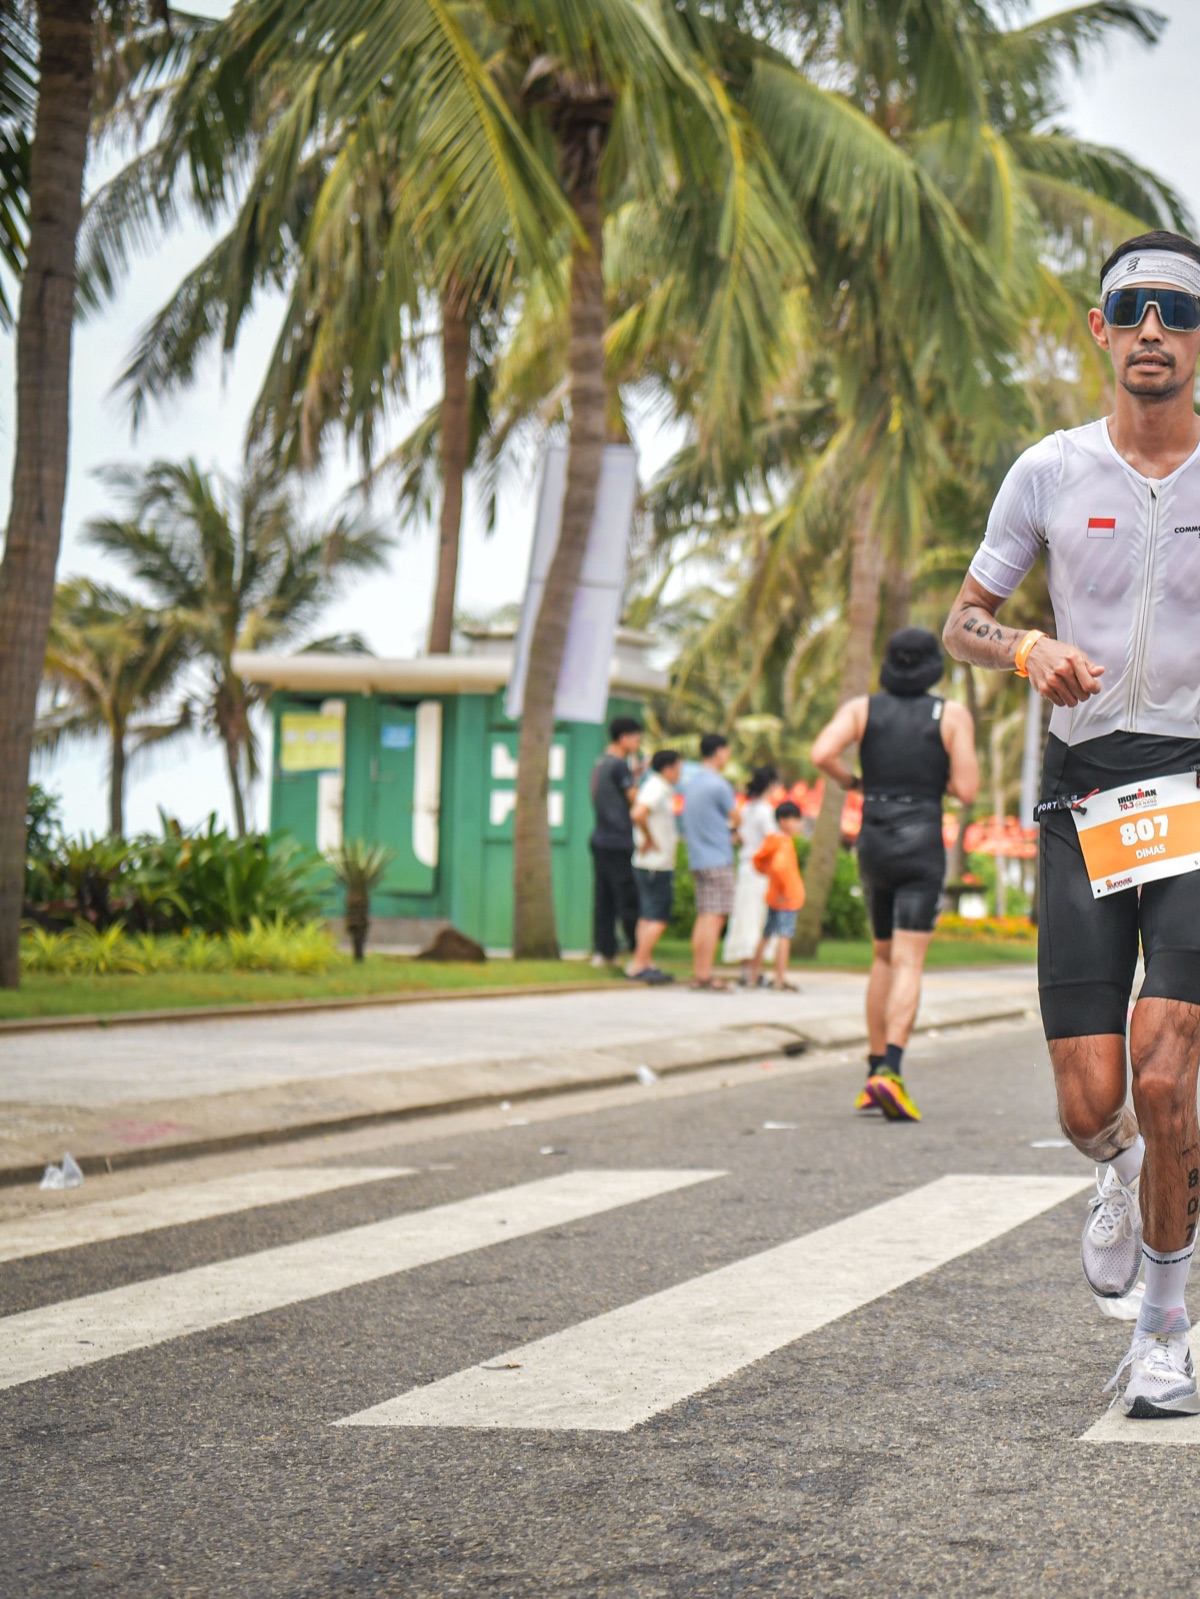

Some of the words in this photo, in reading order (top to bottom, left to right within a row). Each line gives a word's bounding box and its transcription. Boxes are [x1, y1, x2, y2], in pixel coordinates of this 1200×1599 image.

[1118, 788, 1157, 804] IRONMAN
[1119, 801, 1134, 811] 70.3
[1120, 814, 1168, 846] 807
[1136, 844, 1166, 859] DIMAS
